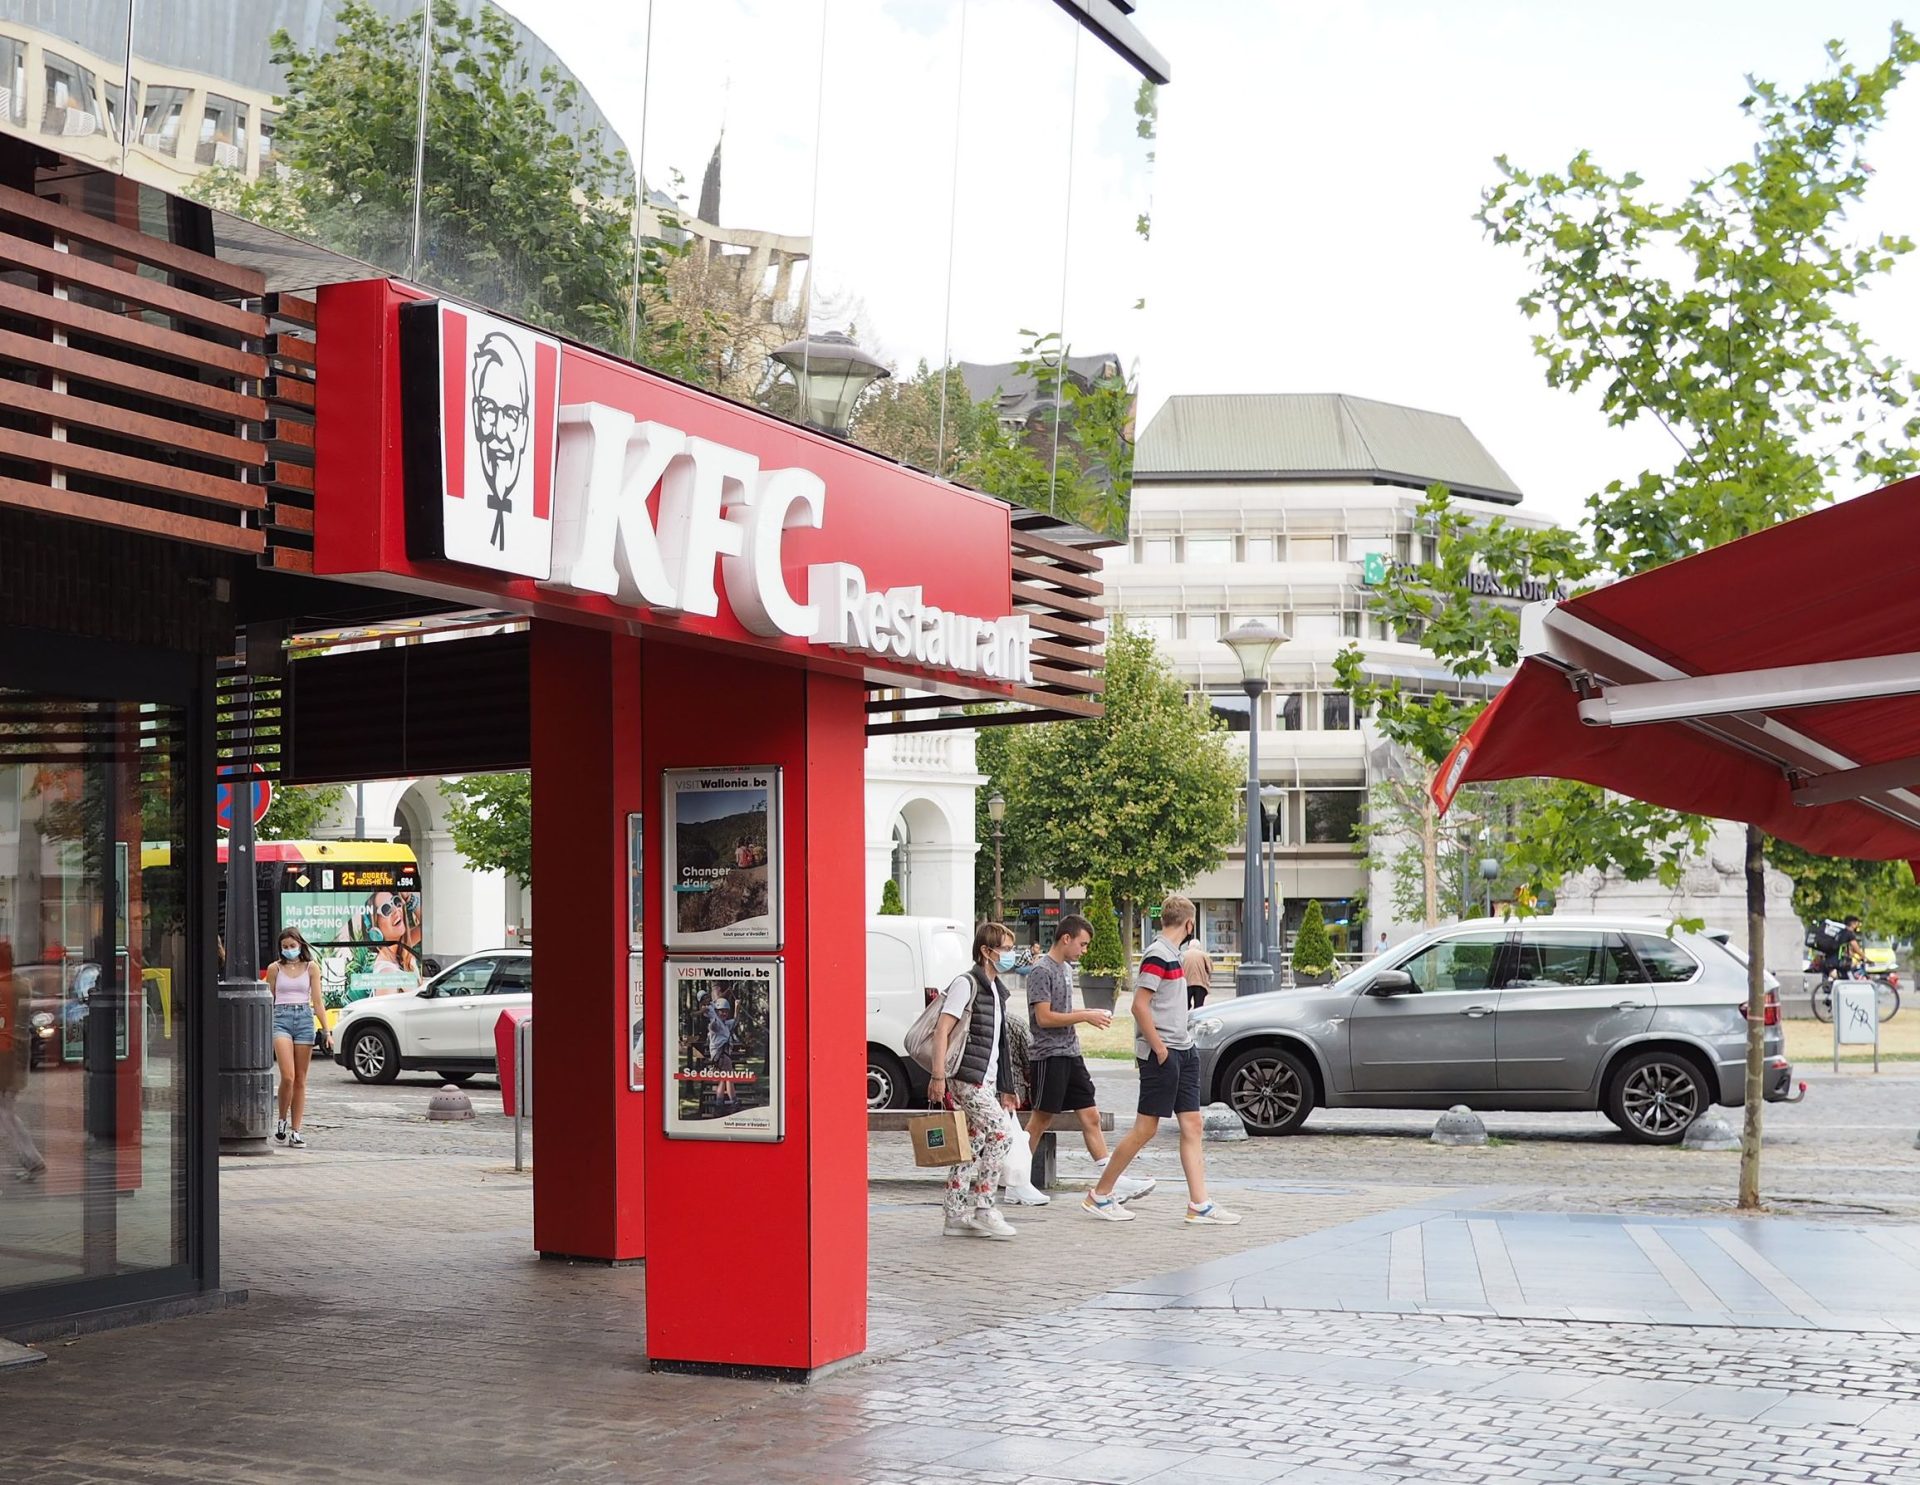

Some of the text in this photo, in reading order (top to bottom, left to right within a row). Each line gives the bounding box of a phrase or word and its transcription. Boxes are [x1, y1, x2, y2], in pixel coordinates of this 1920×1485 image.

[552, 401, 826, 638] KFC
[808, 561, 1033, 685] Restaurant
[676, 777, 767, 789] VISITWallonia.be
[682, 866, 731, 878] Changer
[342, 872, 355, 885] 25
[286, 905, 374, 915] Ma DESTINATION
[286, 918, 342, 929] SHOPPING
[678, 967, 770, 977] VISITWallonia.be
[684, 1067, 754, 1079] Se découvrir
